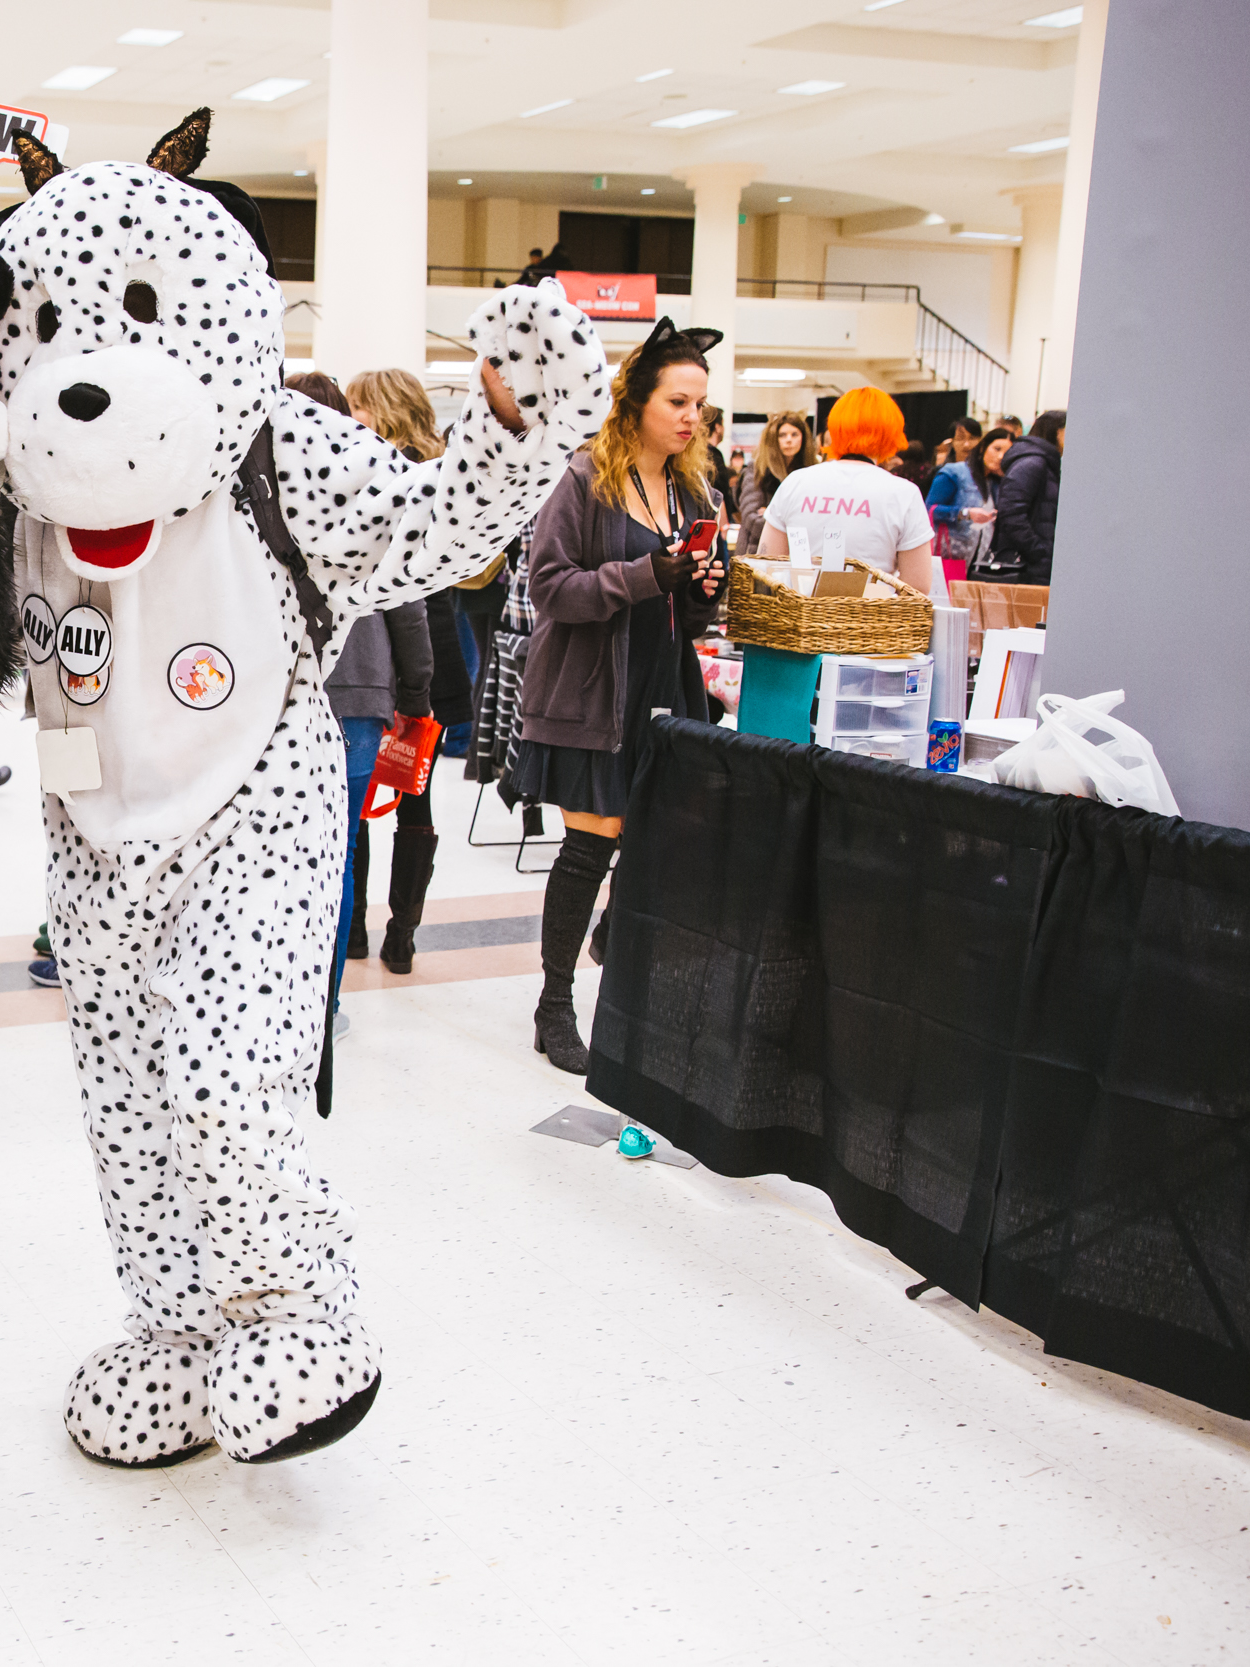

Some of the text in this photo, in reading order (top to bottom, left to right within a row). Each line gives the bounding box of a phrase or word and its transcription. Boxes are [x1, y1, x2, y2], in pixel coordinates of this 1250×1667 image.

[801, 496, 871, 518] NINA
[23, 607, 54, 651] ALLY
[60, 625, 106, 657] ALLY
